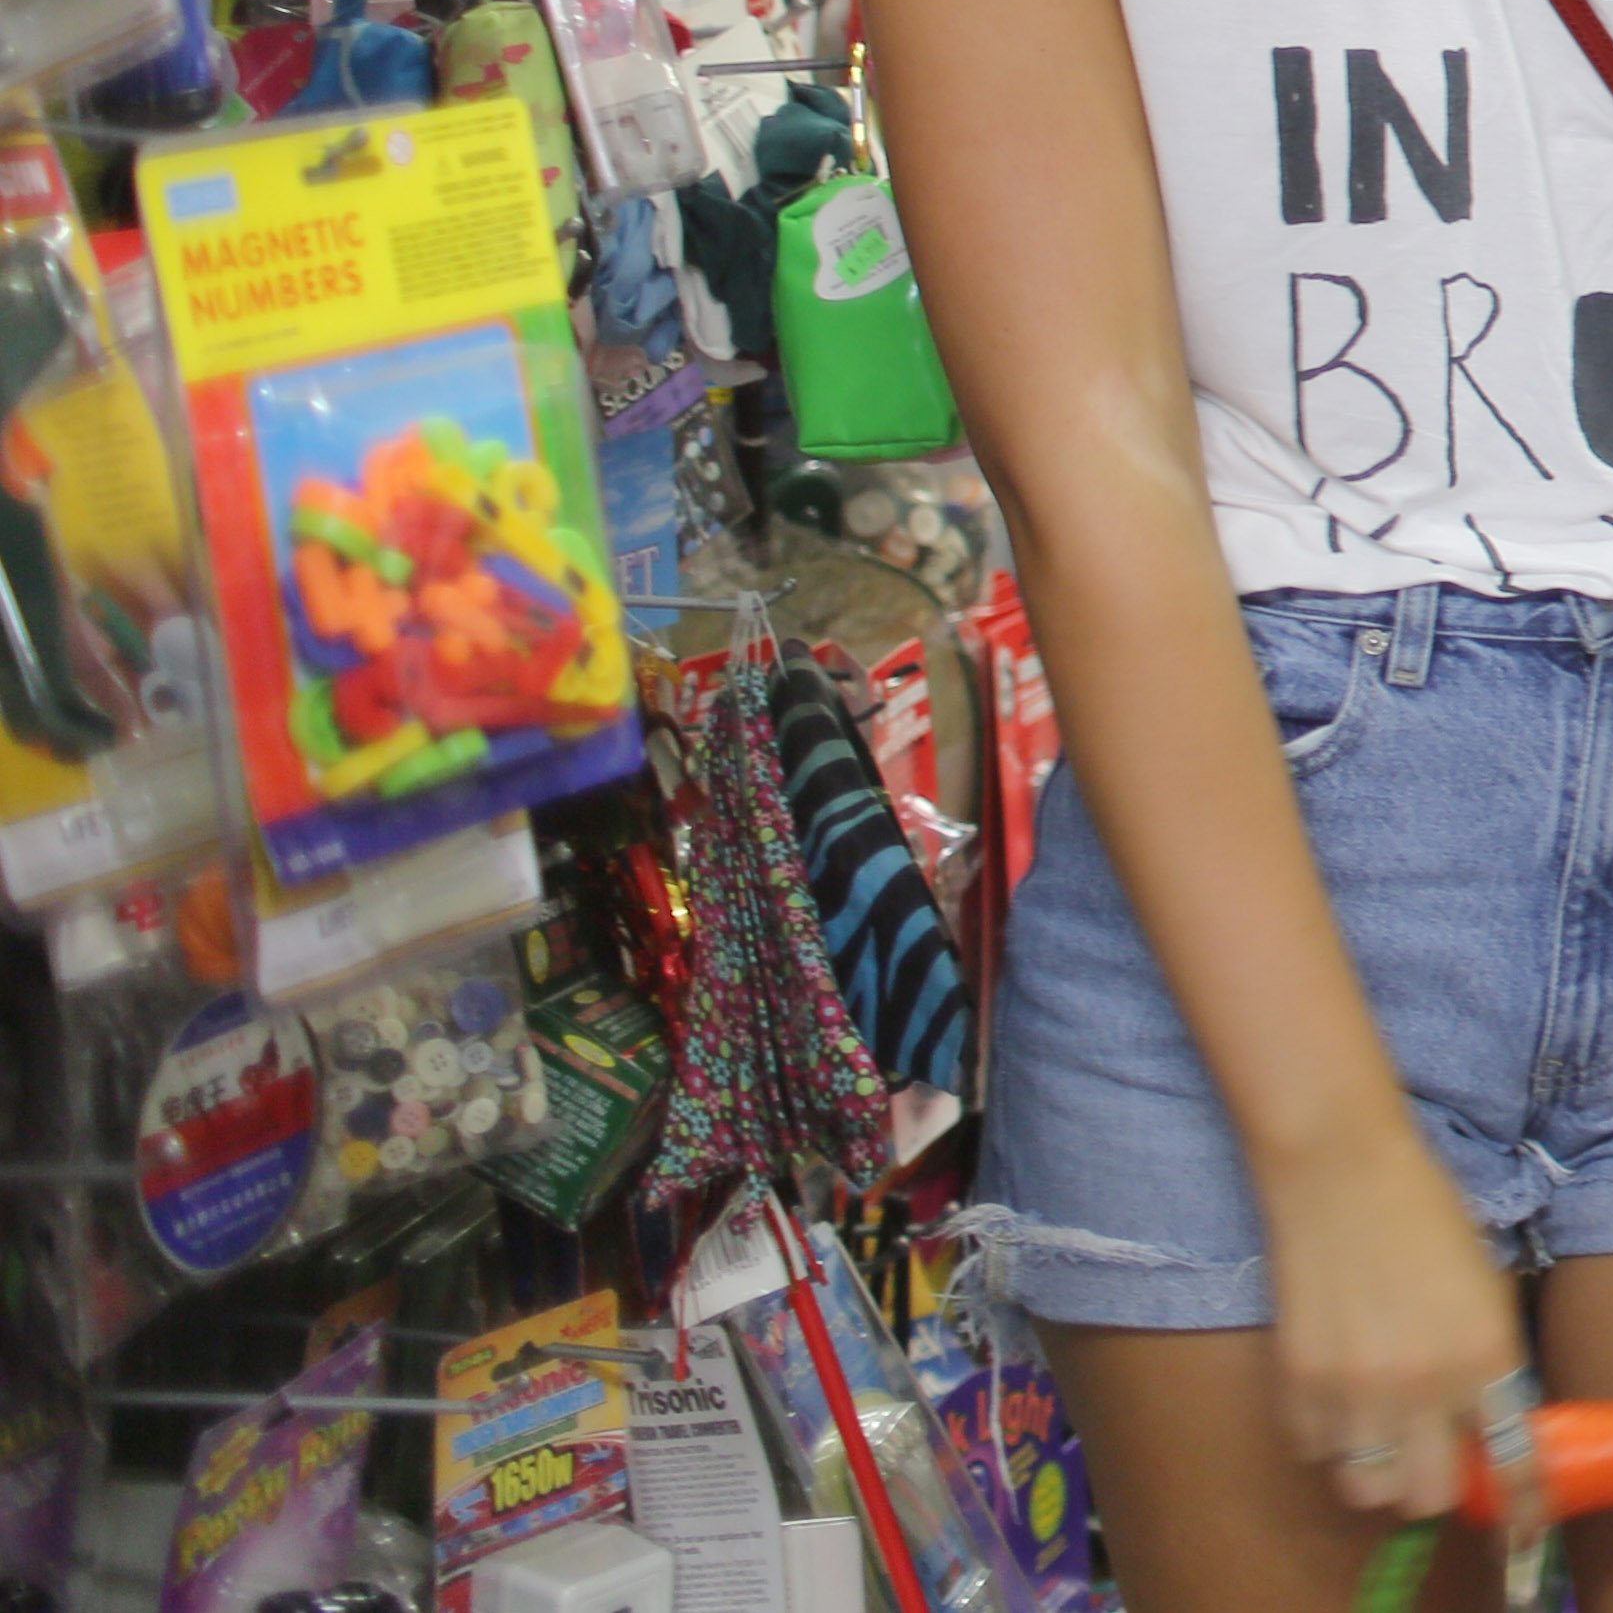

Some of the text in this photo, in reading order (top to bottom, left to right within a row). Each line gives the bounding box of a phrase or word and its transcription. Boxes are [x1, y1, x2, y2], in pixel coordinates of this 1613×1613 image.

[1272, 46, 1473, 224] IN
[180, 211, 368, 282] MAGNETIC
[188, 258, 366, 328] NUMBERS
